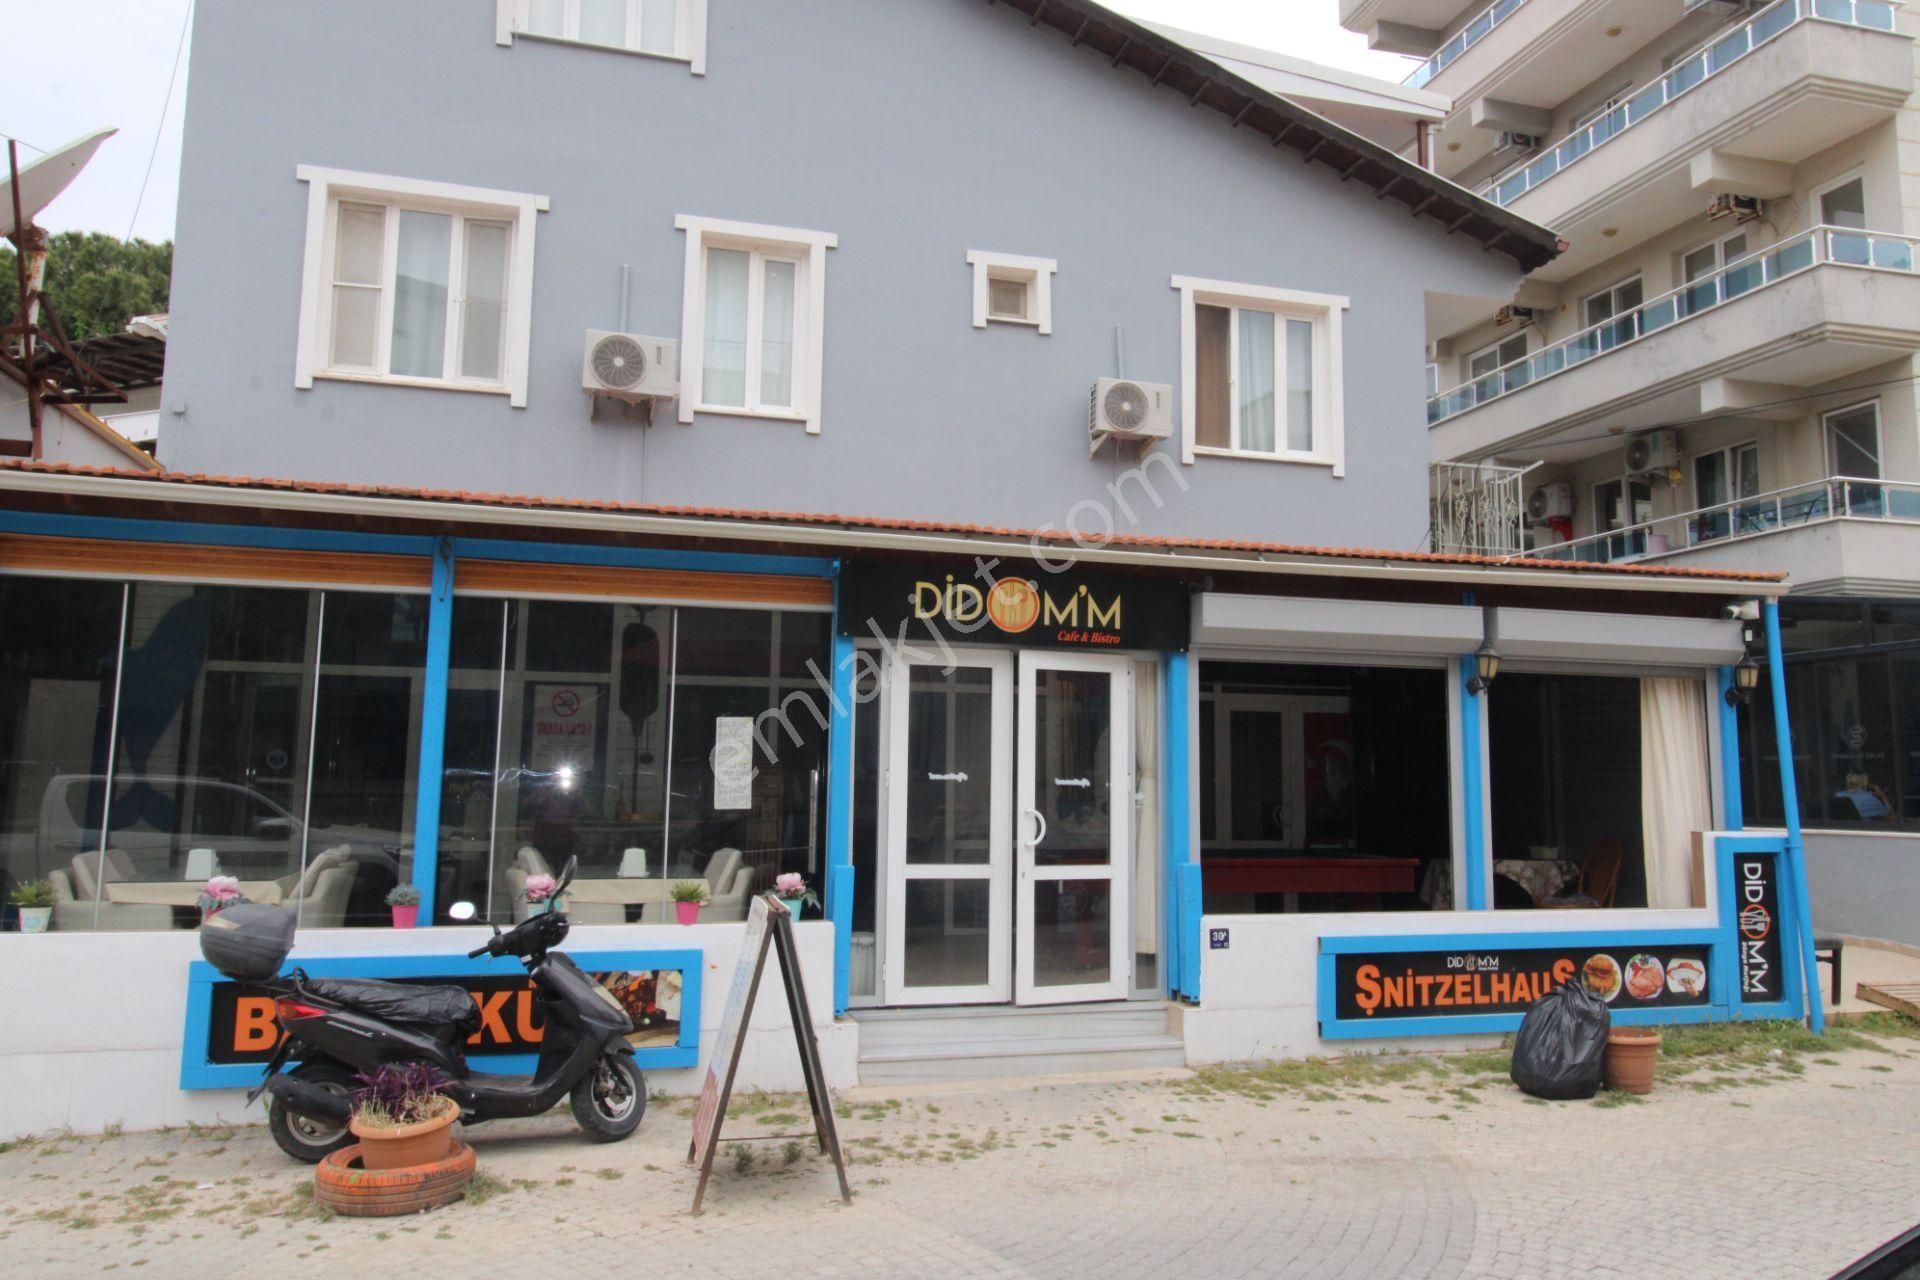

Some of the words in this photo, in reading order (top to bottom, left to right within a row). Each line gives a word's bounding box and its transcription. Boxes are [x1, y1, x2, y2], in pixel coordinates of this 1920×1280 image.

[1057, 629, 1080, 642] Cafe
[1080, 631, 1089, 643] &
[1090, 631, 1121, 644] Bistro
